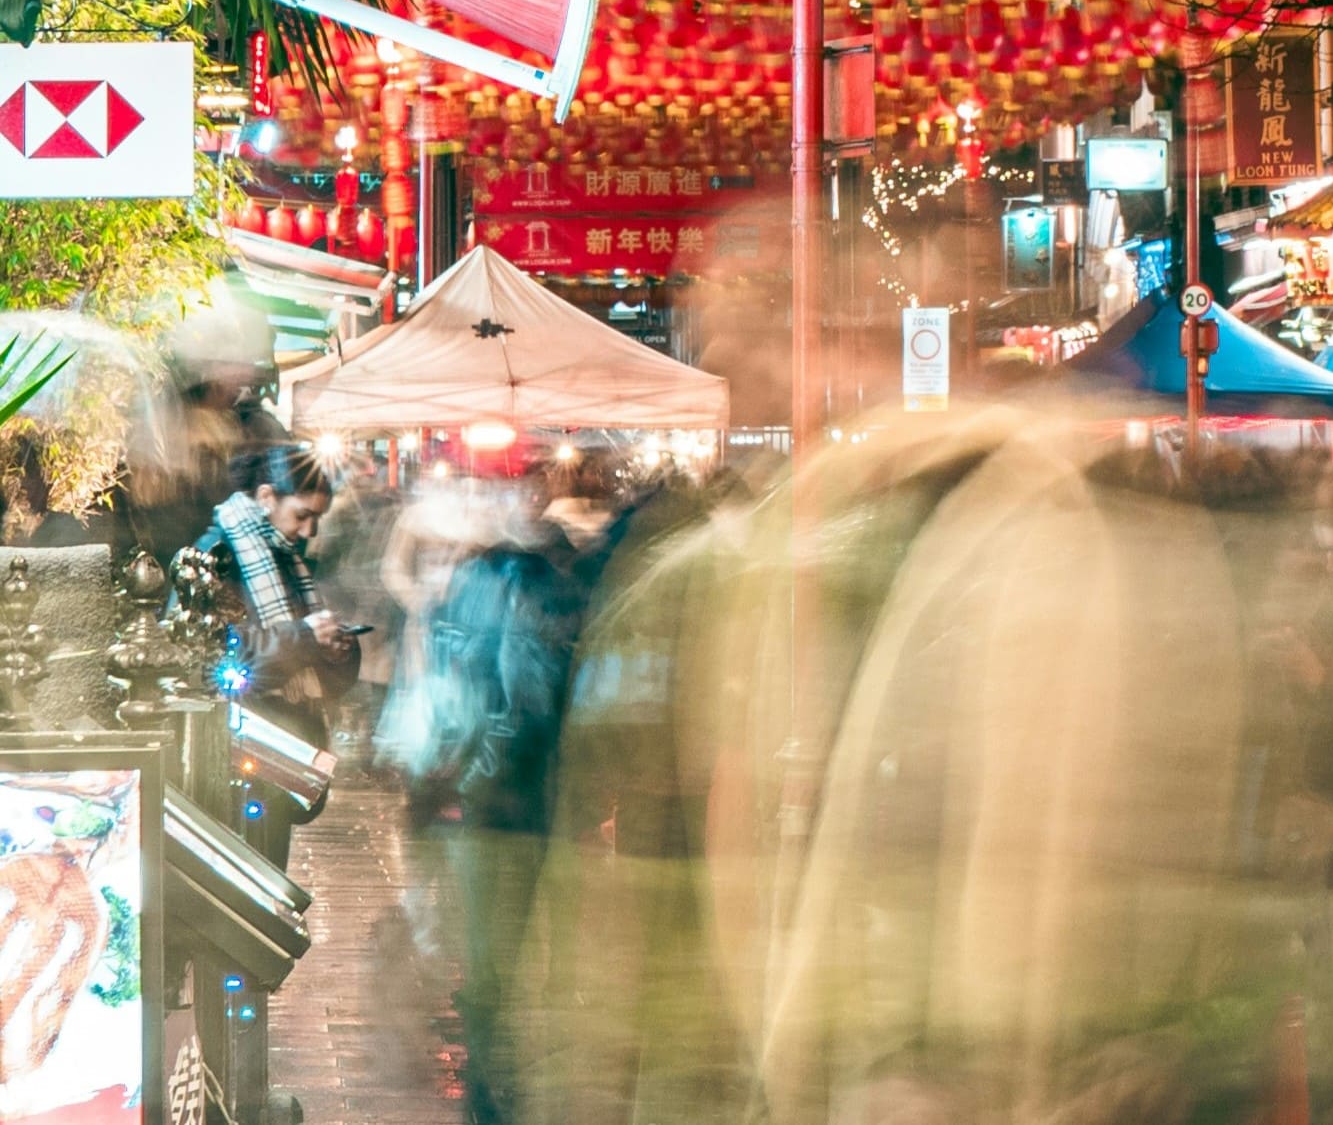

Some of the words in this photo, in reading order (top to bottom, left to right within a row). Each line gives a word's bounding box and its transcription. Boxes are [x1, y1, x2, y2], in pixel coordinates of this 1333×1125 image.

[1255, 42, 1293, 147] 新龍鳳
[1261, 151, 1294, 164] NEW
[1236, 166, 1274, 178] LOON
[585, 170, 702, 197] 財源廣進
[586, 227, 704, 255] 新年快樂
[1185, 293, 1208, 308] 20
